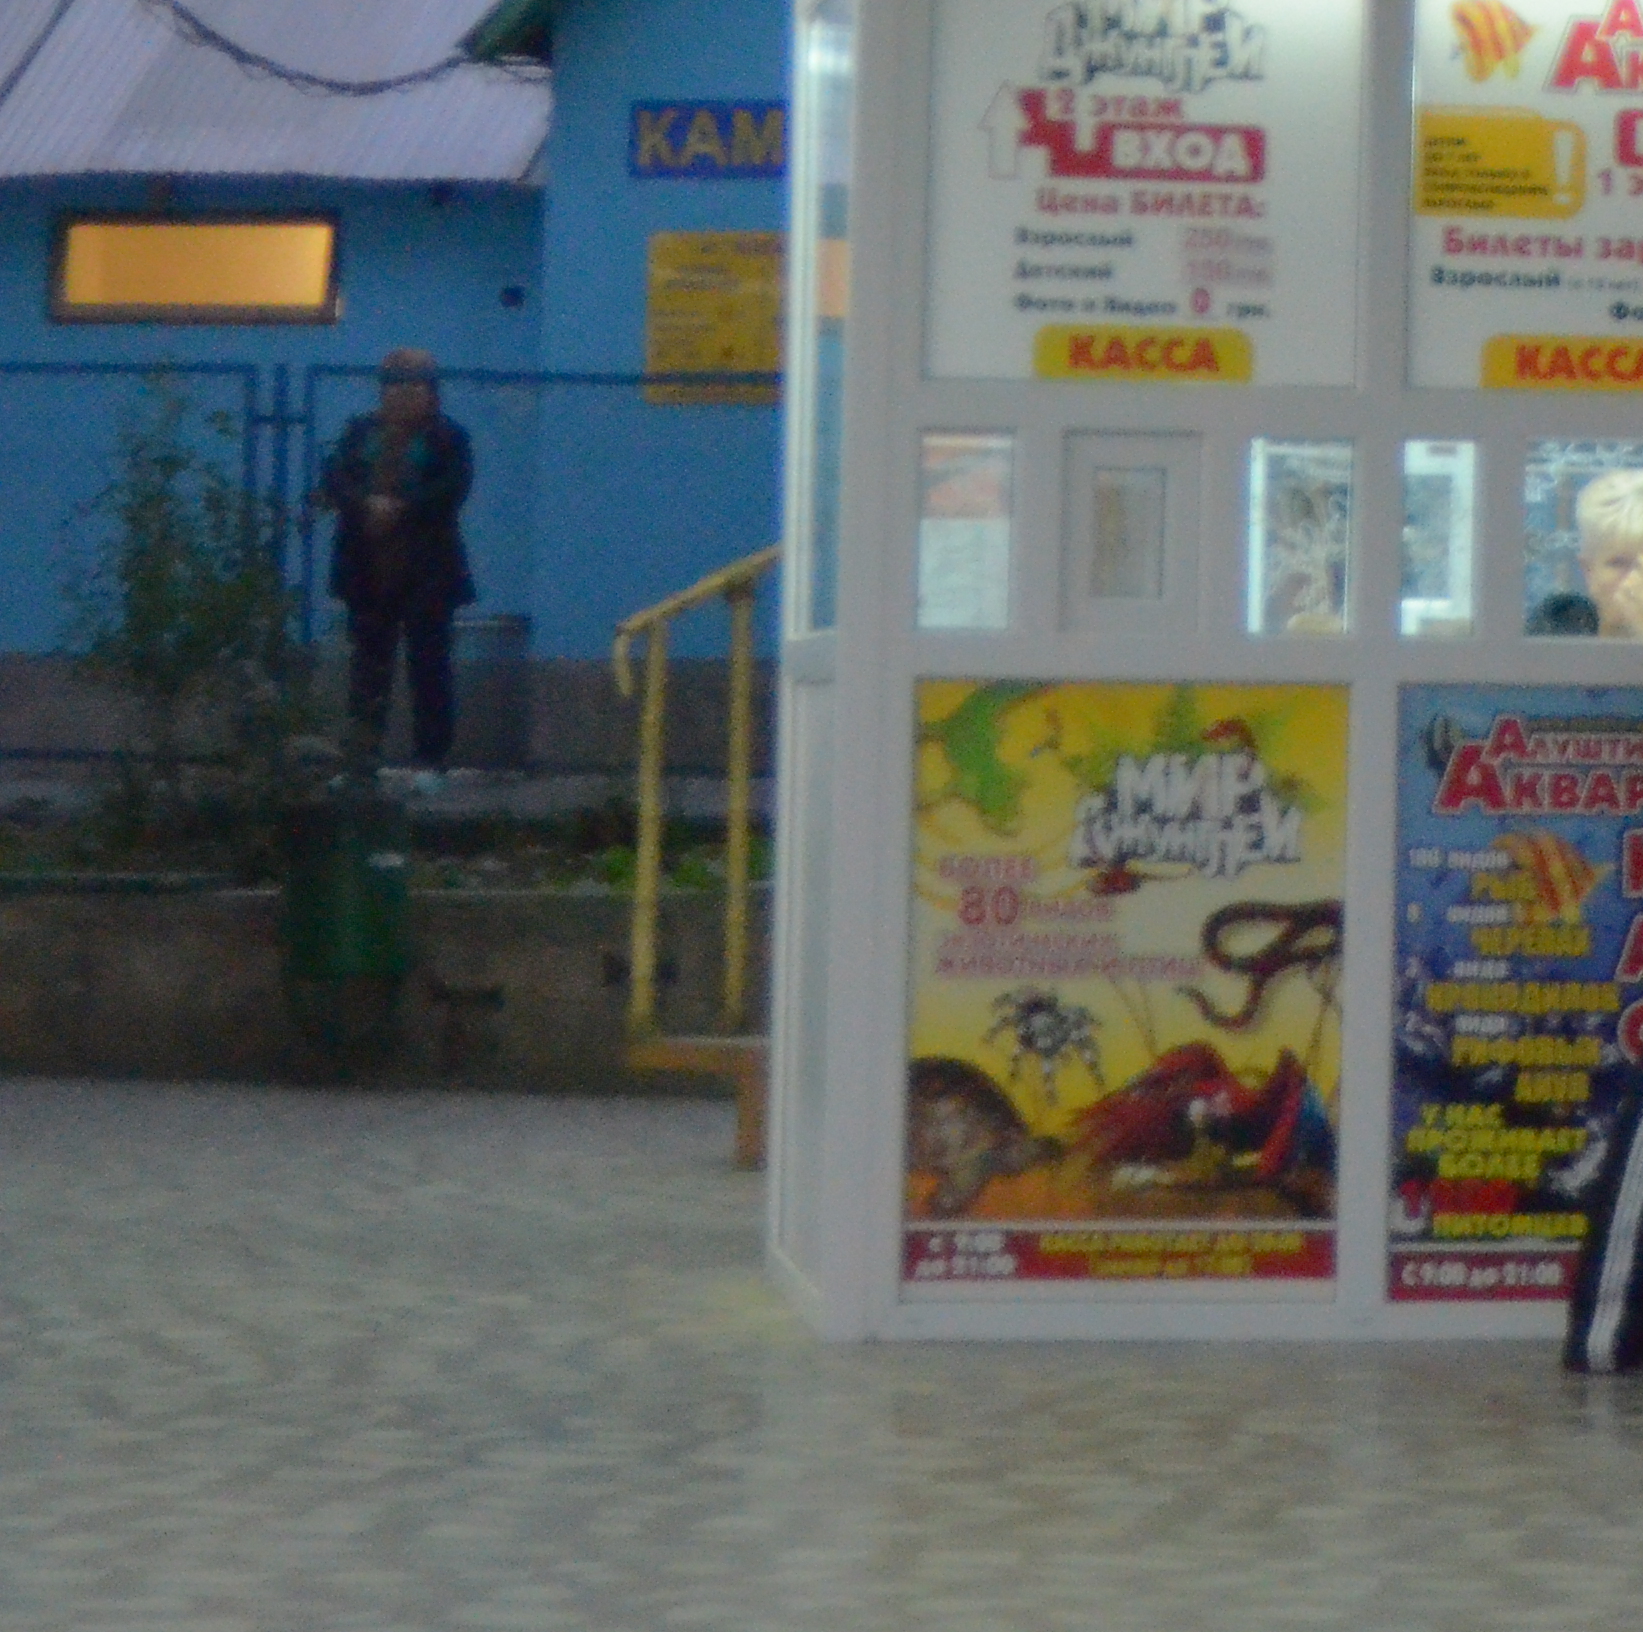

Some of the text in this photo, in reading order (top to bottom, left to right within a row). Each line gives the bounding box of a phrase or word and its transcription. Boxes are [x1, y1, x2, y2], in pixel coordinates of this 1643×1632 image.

[636, 108, 785, 167] КАМ
[1110, 128, 1253, 177] ВХОД
[1441, 225, 1585, 260] Билеты
[1067, 333, 1222, 375] КАССА
[957, 884, 1021, 927] 80
